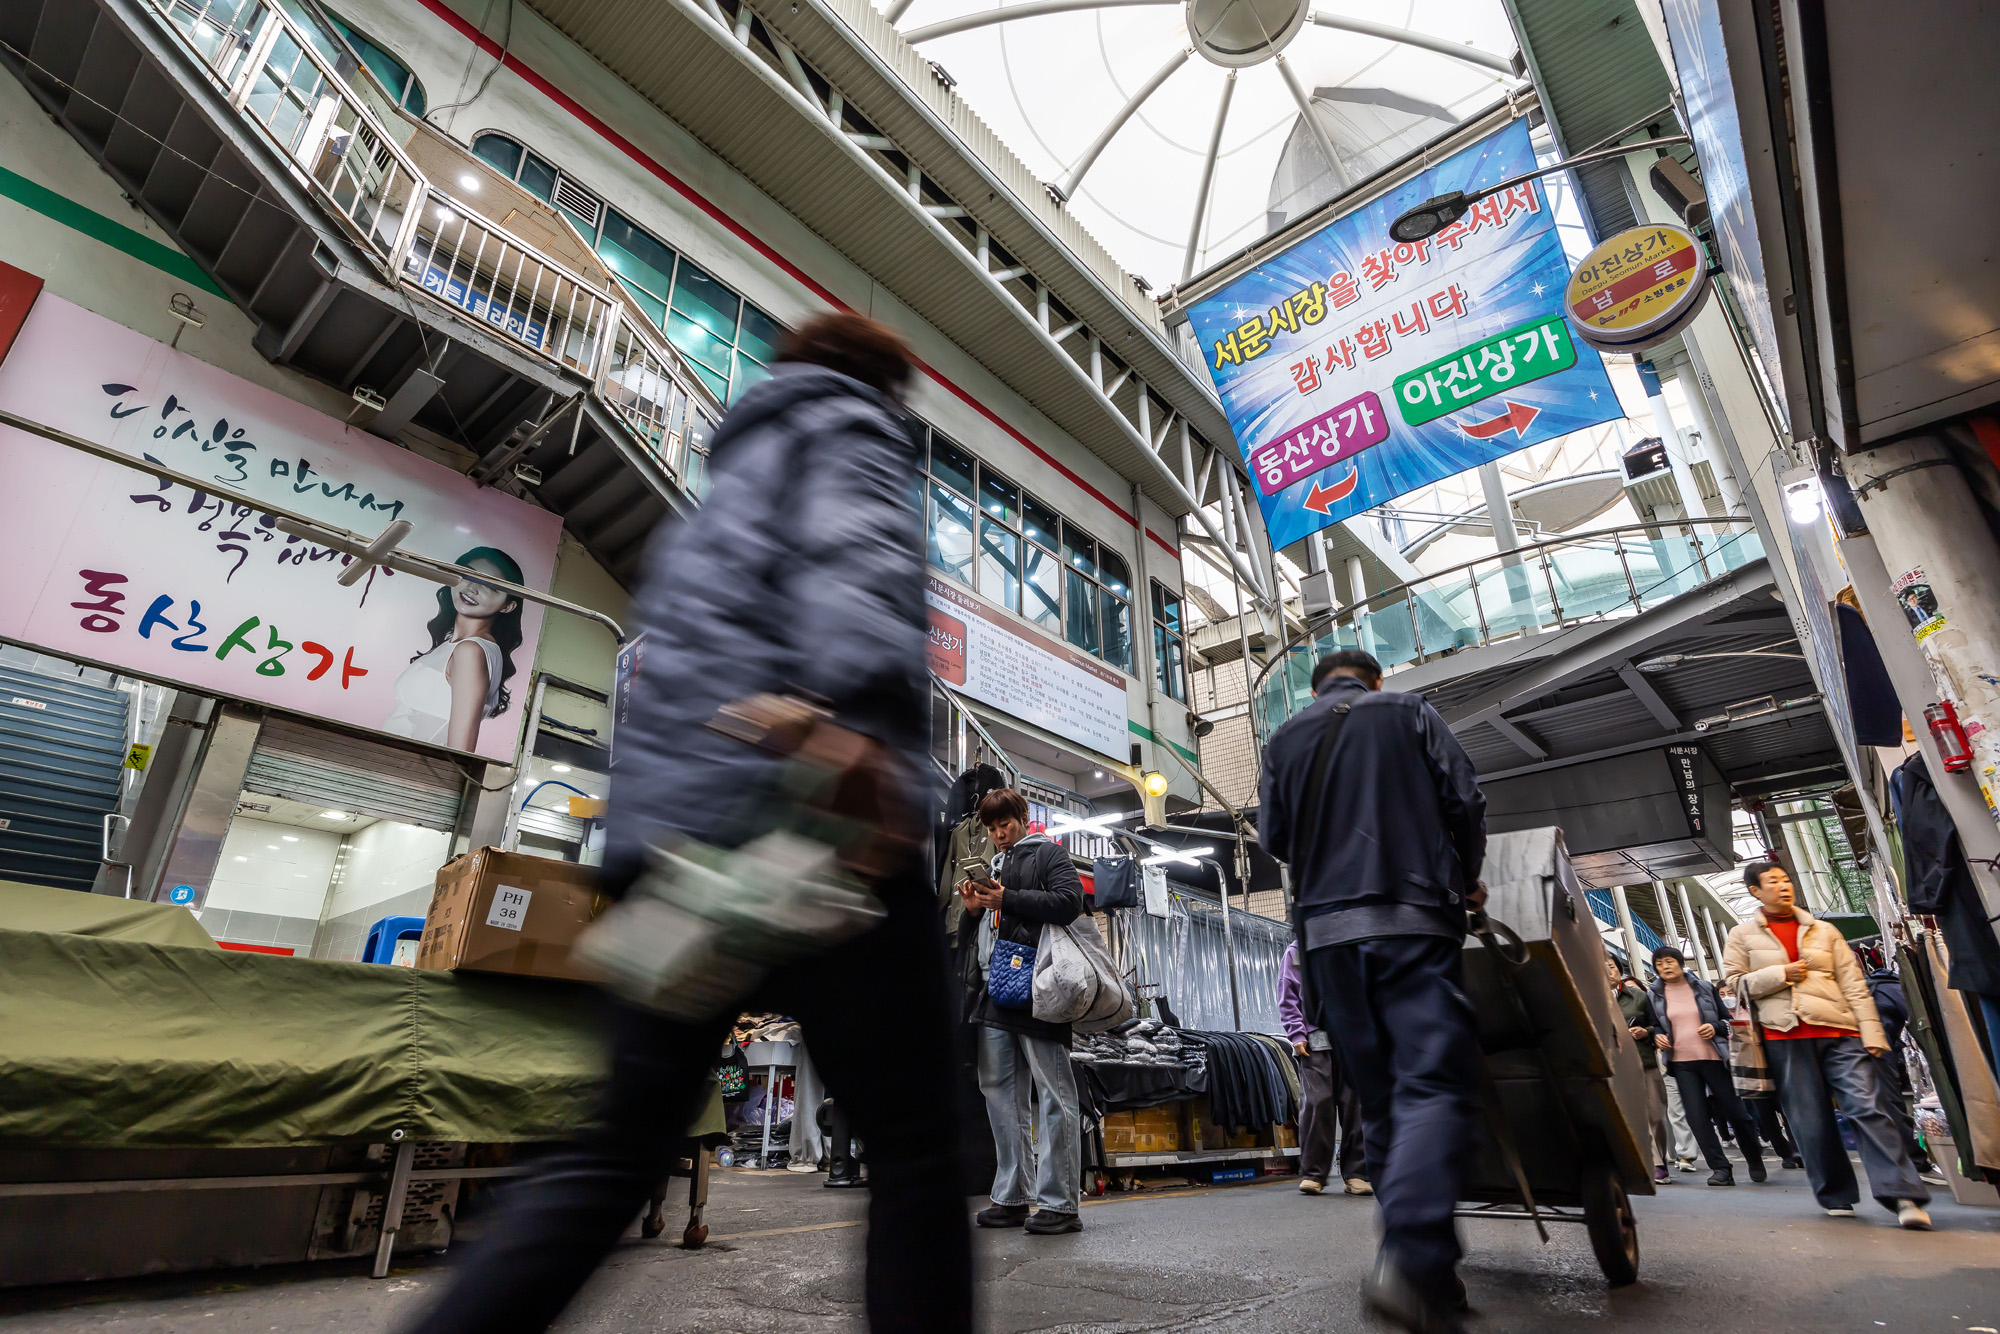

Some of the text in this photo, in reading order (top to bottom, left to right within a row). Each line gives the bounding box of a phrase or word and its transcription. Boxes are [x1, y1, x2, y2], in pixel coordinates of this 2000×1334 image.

[1213, 180, 1541, 370] 서문시장을 찾아 주셔서
[1579, 230, 1667, 284] 아진상가
[1582, 244, 1676, 296] Daegu Seomun Market
[1592, 260, 1677, 311] 남 로
[1618, 278, 1687, 317] 119 소방통로
[1289, 282, 1468, 396] 감사합니다
[1402, 324, 1560, 406] 아진상가
[102, 383, 404, 522] 당신을 만나서
[1258, 400, 1378, 486] 동산상가
[929, 578, 956, 602] 서문시장
[70, 569, 369, 690] 동산상가
[926, 625, 964, 656] 산상가
[1670, 747, 1697, 755] 서문시장
[1681, 758, 1701, 830] 만남의 장소 1
[499, 908, 517, 919] 38
[502, 892, 523, 905] PH
